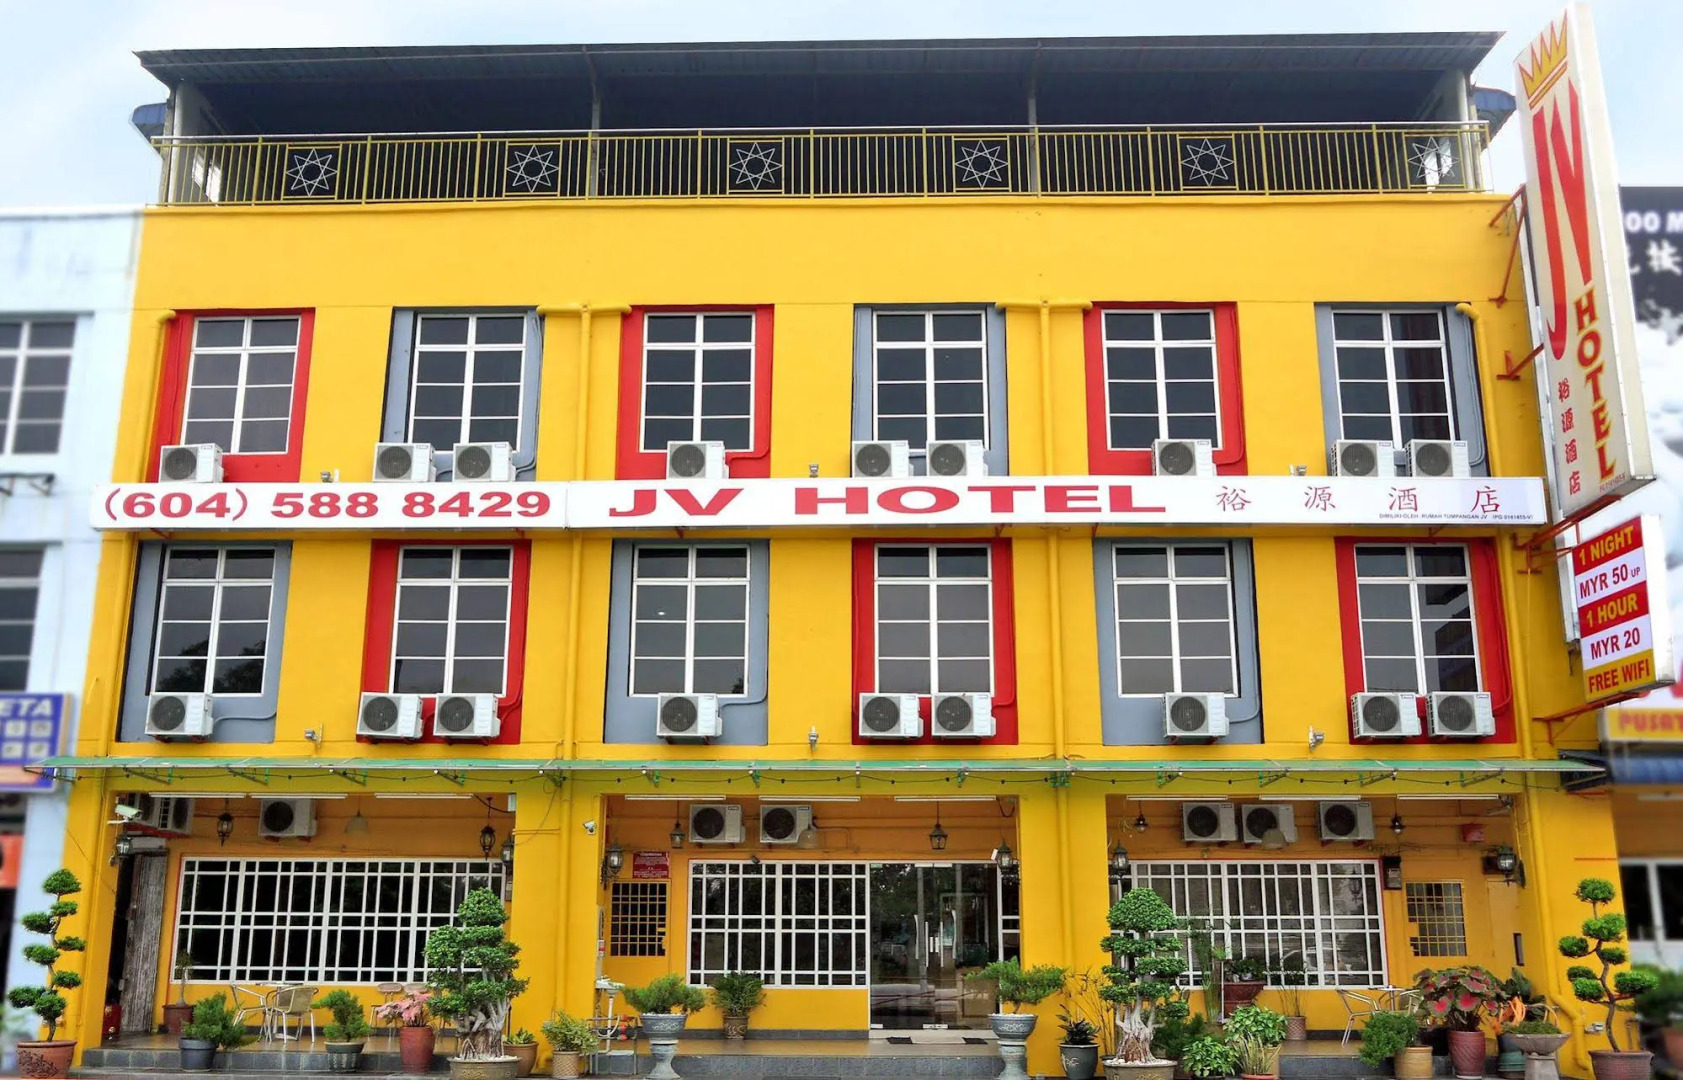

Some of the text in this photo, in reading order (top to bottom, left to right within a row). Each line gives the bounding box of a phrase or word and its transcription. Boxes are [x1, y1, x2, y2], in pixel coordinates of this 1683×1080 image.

[1573, 285, 1617, 481] HOTEL
[1556, 377, 1583, 496] 裕源酒店
[105, 488, 551, 521] (604) 588 8429
[609, 485, 1166, 517] JV HOTEL
[1579, 525, 1634, 566] 1 NIGHT
[1579, 563, 1641, 599] MYR 50 UP
[1586, 592, 1639, 628] 1 HOUR
[1590, 627, 1641, 660] MYR 20
[1588, 668, 1619, 694] FREE
[1621, 658, 1650, 683] WIFI
